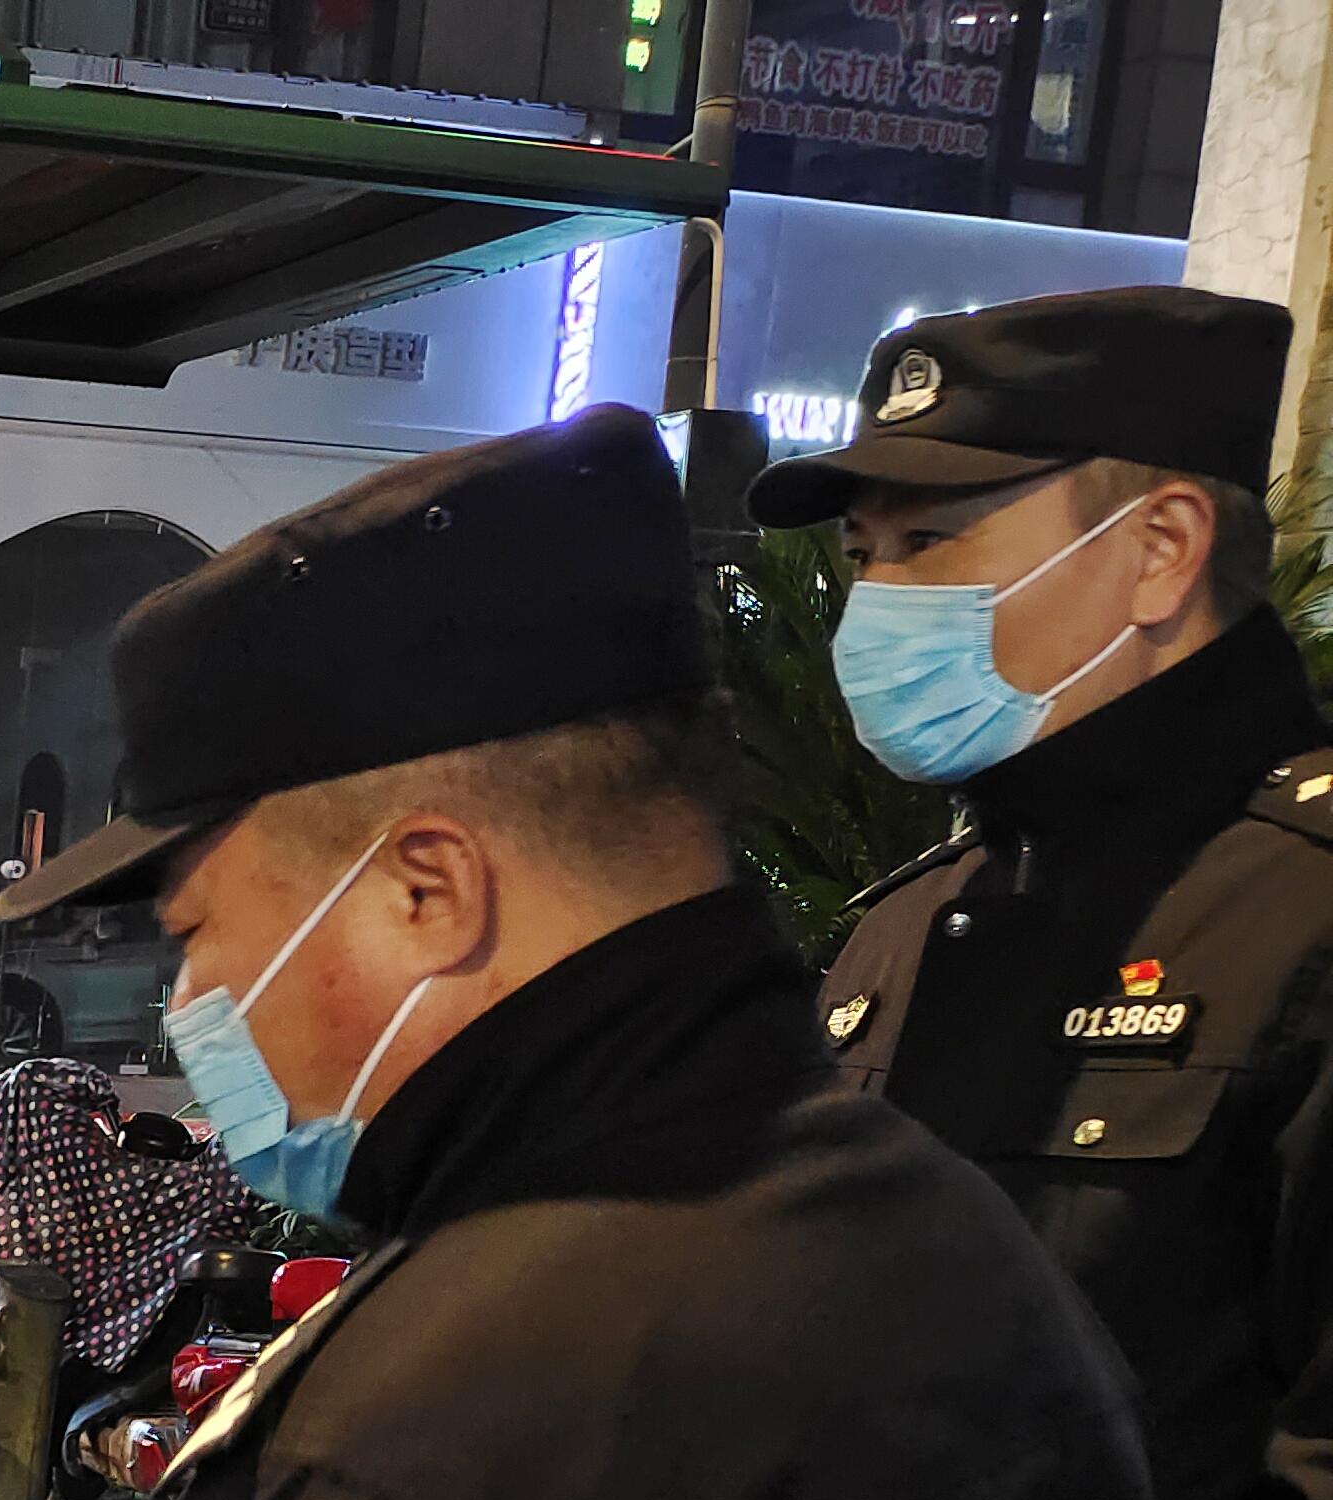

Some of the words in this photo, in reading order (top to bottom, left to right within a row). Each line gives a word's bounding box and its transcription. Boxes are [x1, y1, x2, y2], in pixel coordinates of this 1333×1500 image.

[813, 46, 906, 107] 不打针
[909, 59, 1001, 116] 不吃药
[1064, 1003, 1187, 1037] 013869
